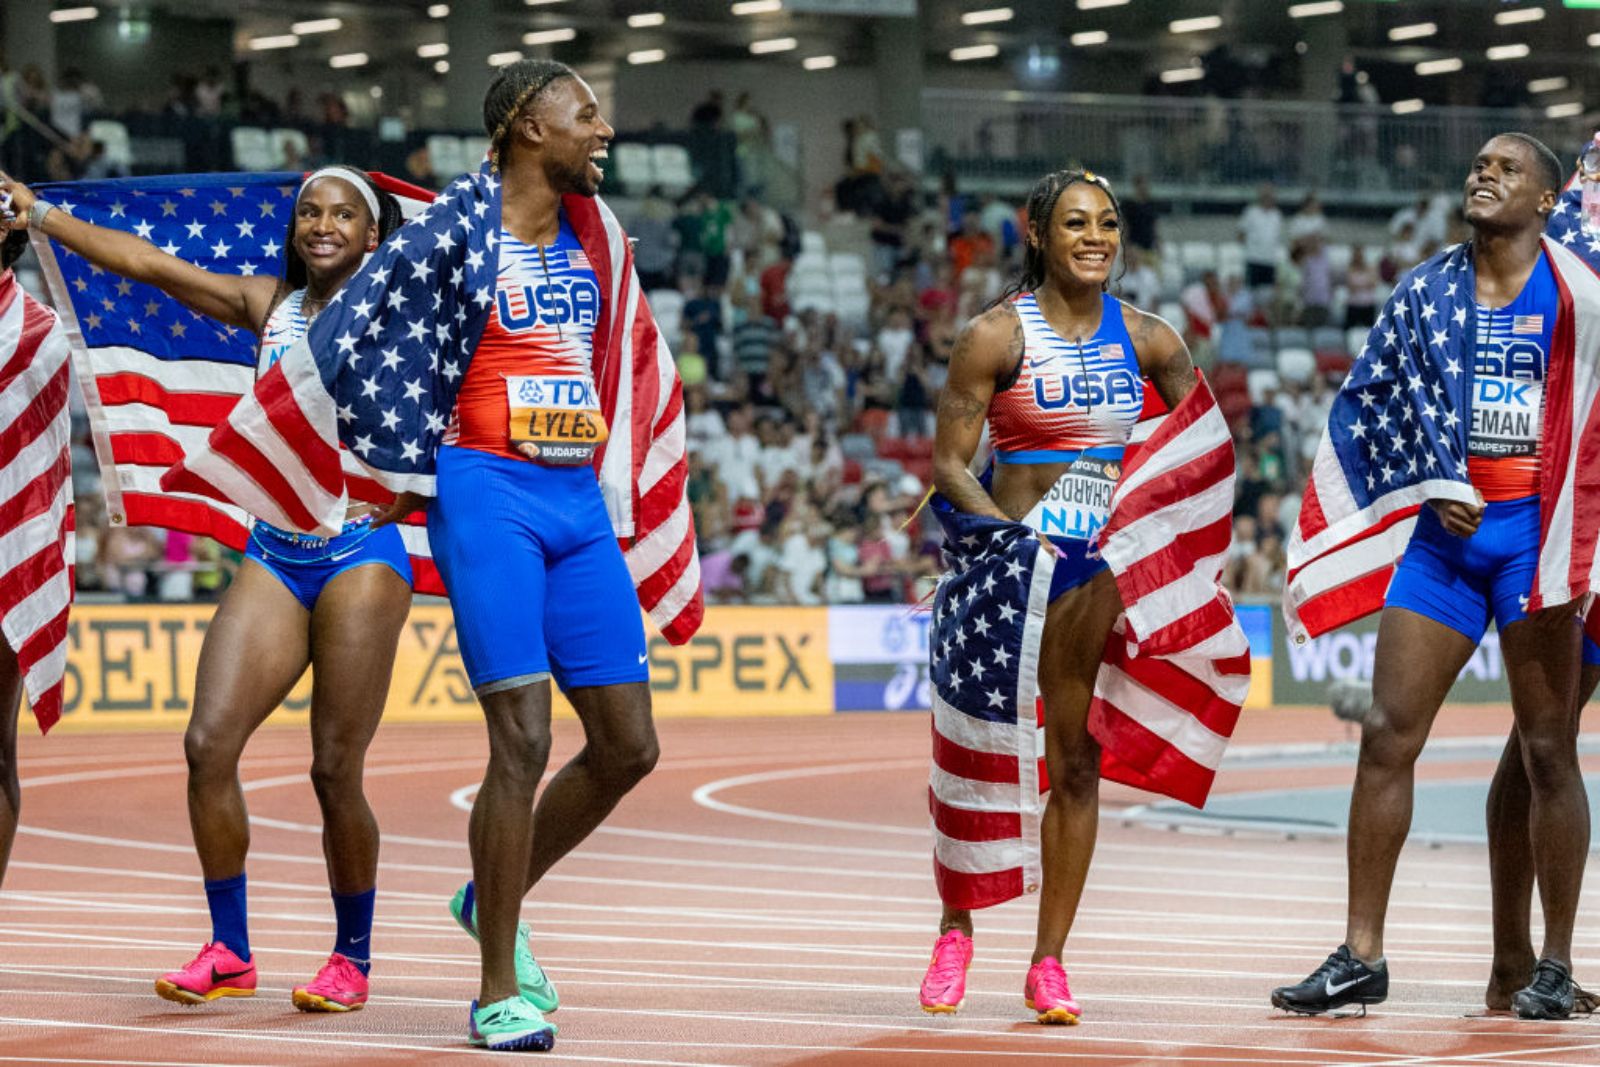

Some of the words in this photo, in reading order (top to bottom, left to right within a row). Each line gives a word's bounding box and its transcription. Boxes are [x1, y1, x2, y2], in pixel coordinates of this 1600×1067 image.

[496, 279, 600, 333] USA
[1034, 369, 1139, 410] USA
[528, 411, 598, 439] LYLES
[1041, 477, 1115, 507] CHARDS
